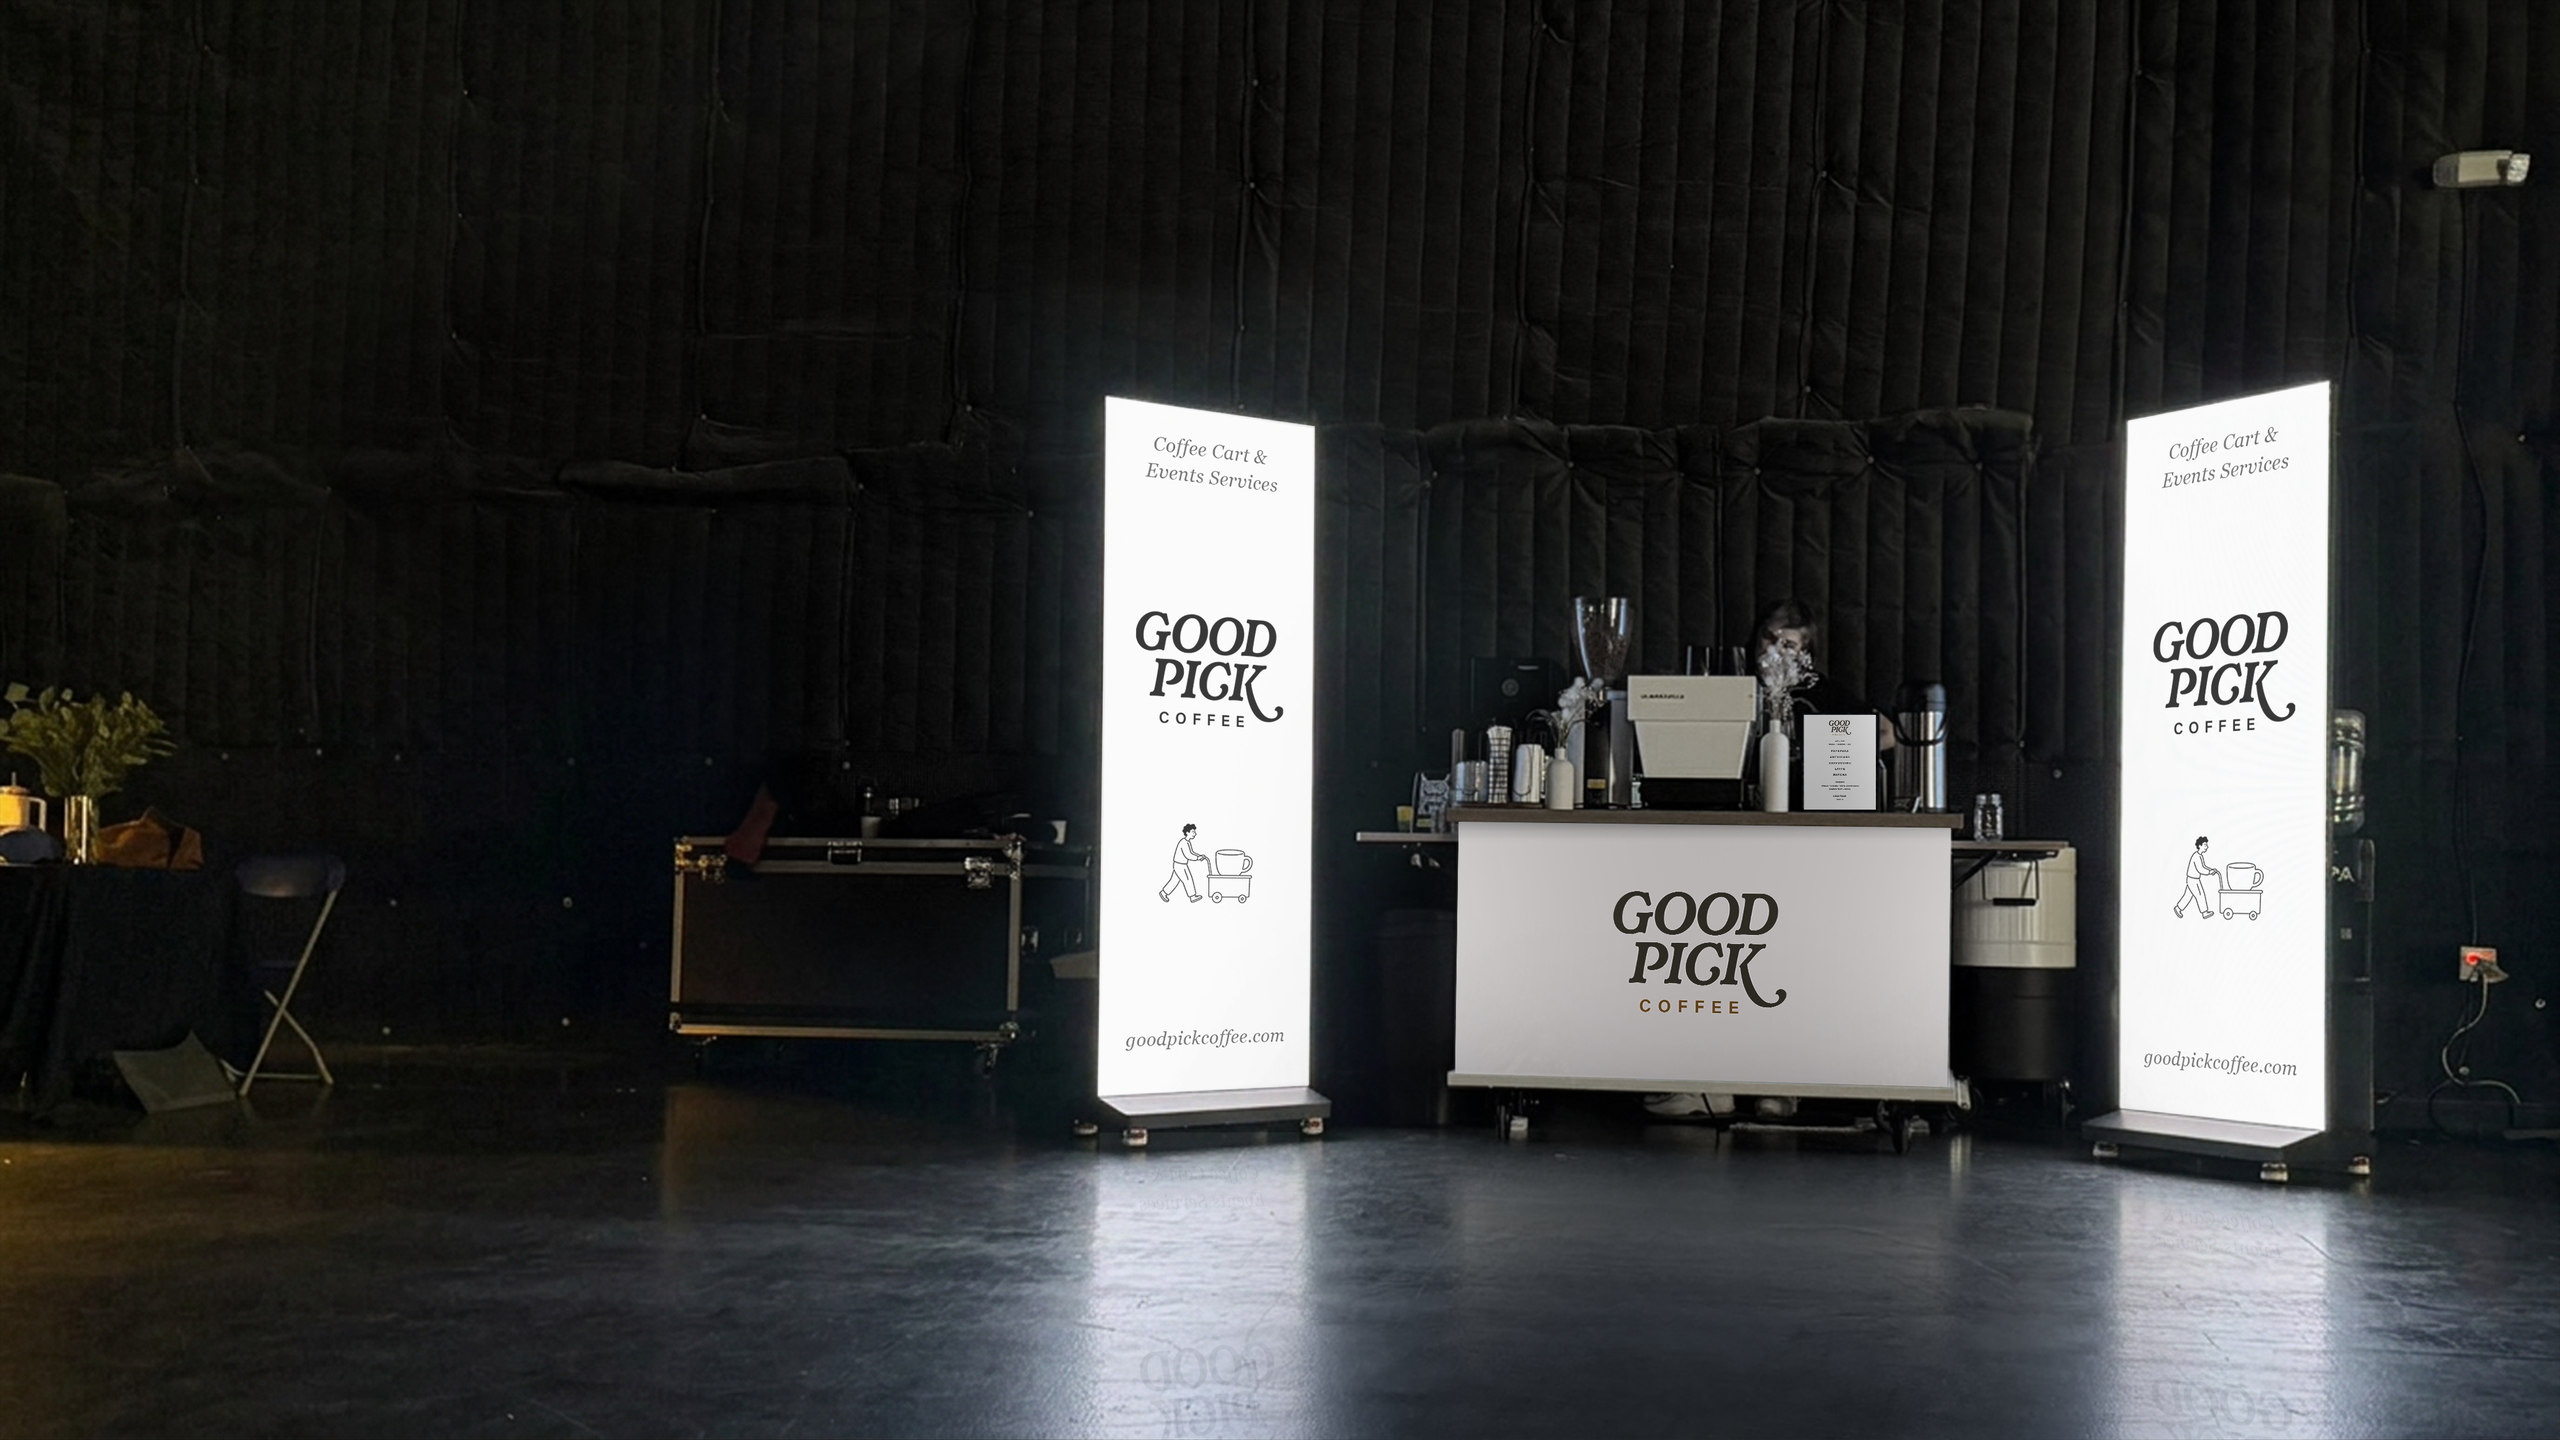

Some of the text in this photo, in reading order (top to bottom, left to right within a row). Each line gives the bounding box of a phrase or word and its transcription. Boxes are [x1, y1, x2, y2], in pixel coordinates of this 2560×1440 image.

[1153, 436, 1268, 466] Coffee Cart &
[2168, 426, 2279, 462] Coffee Cart &
[1144, 462, 1278, 493] Events Services
[2161, 456, 2290, 489] Events Services
[1135, 610, 1278, 658] GOOD
[2152, 610, 2289, 664] GOOD
[1148, 657, 1285, 724] PICK
[2164, 659, 2297, 723] PICK
[1158, 710, 1246, 729] COFFEE
[1828, 719, 1851, 727] GOOD
[2173, 717, 2256, 736] COFFEE
[1612, 890, 1779, 937] GOOD
[1628, 941, 1788, 1009] PICK
[1639, 998, 1740, 1015] COFFEE
[1124, 1028, 1285, 1052] goodpickcoffee.com
[2143, 1050, 2298, 1078] goodpickcoffee.com
